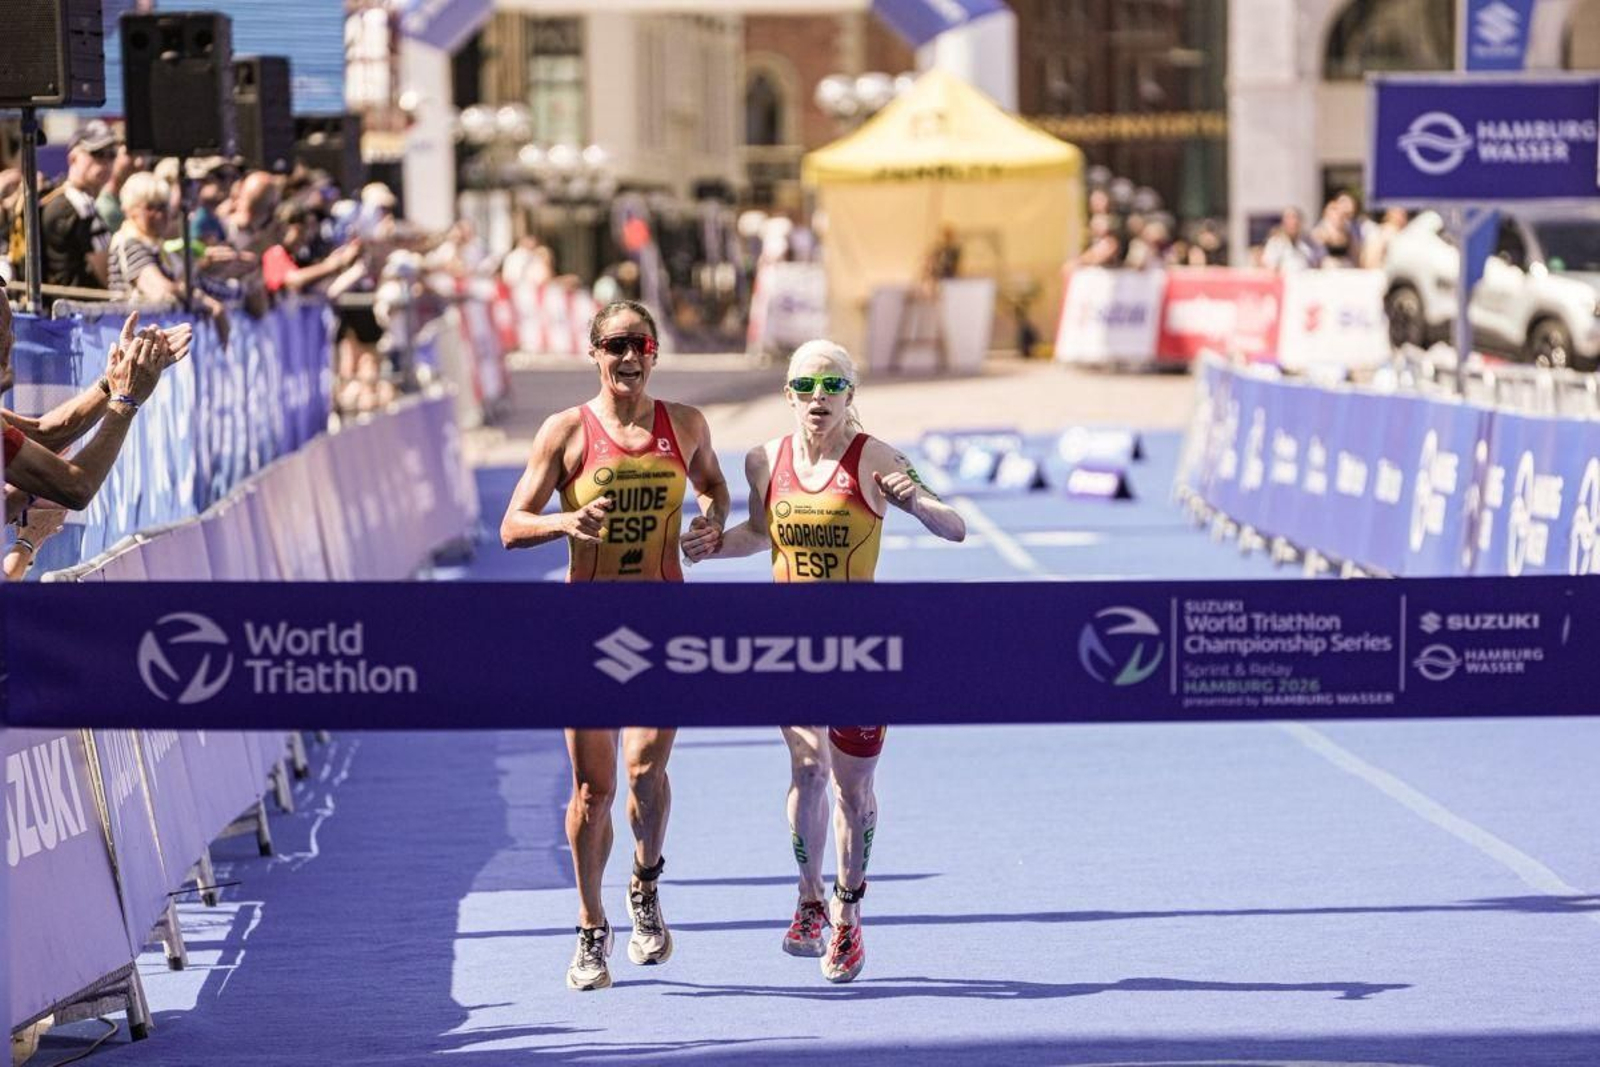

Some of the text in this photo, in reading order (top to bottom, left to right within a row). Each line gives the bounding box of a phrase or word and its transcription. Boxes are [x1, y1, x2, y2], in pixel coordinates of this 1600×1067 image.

[1476, 119, 1597, 142] HAMBURG
[1477, 140, 1570, 163] WASSER
[604, 486, 668, 513] GUIDE
[607, 515, 657, 544] ESP
[777, 523, 850, 547] RODRIGUEZ
[794, 551, 839, 578] ESP
[1184, 600, 1244, 613] SUZUKI
[1184, 613, 1341, 632] World Triathlon
[1447, 614, 1540, 630] SUZUKI
[244, 621, 364, 656] World
[1184, 632, 1392, 656] Championship Series
[665, 636, 904, 674] SUZUKI
[1464, 648, 1544, 661] HAMBURG
[244, 659, 418, 694] Triathlon
[1184, 661, 1293, 679] Sprint & Relay
[1466, 662, 1525, 673] WASSER
[1183, 679, 1320, 694] HAMBURG 2026
[1262, 694, 1334, 706] HAMBURG
[1336, 692, 1394, 705] WASSER
